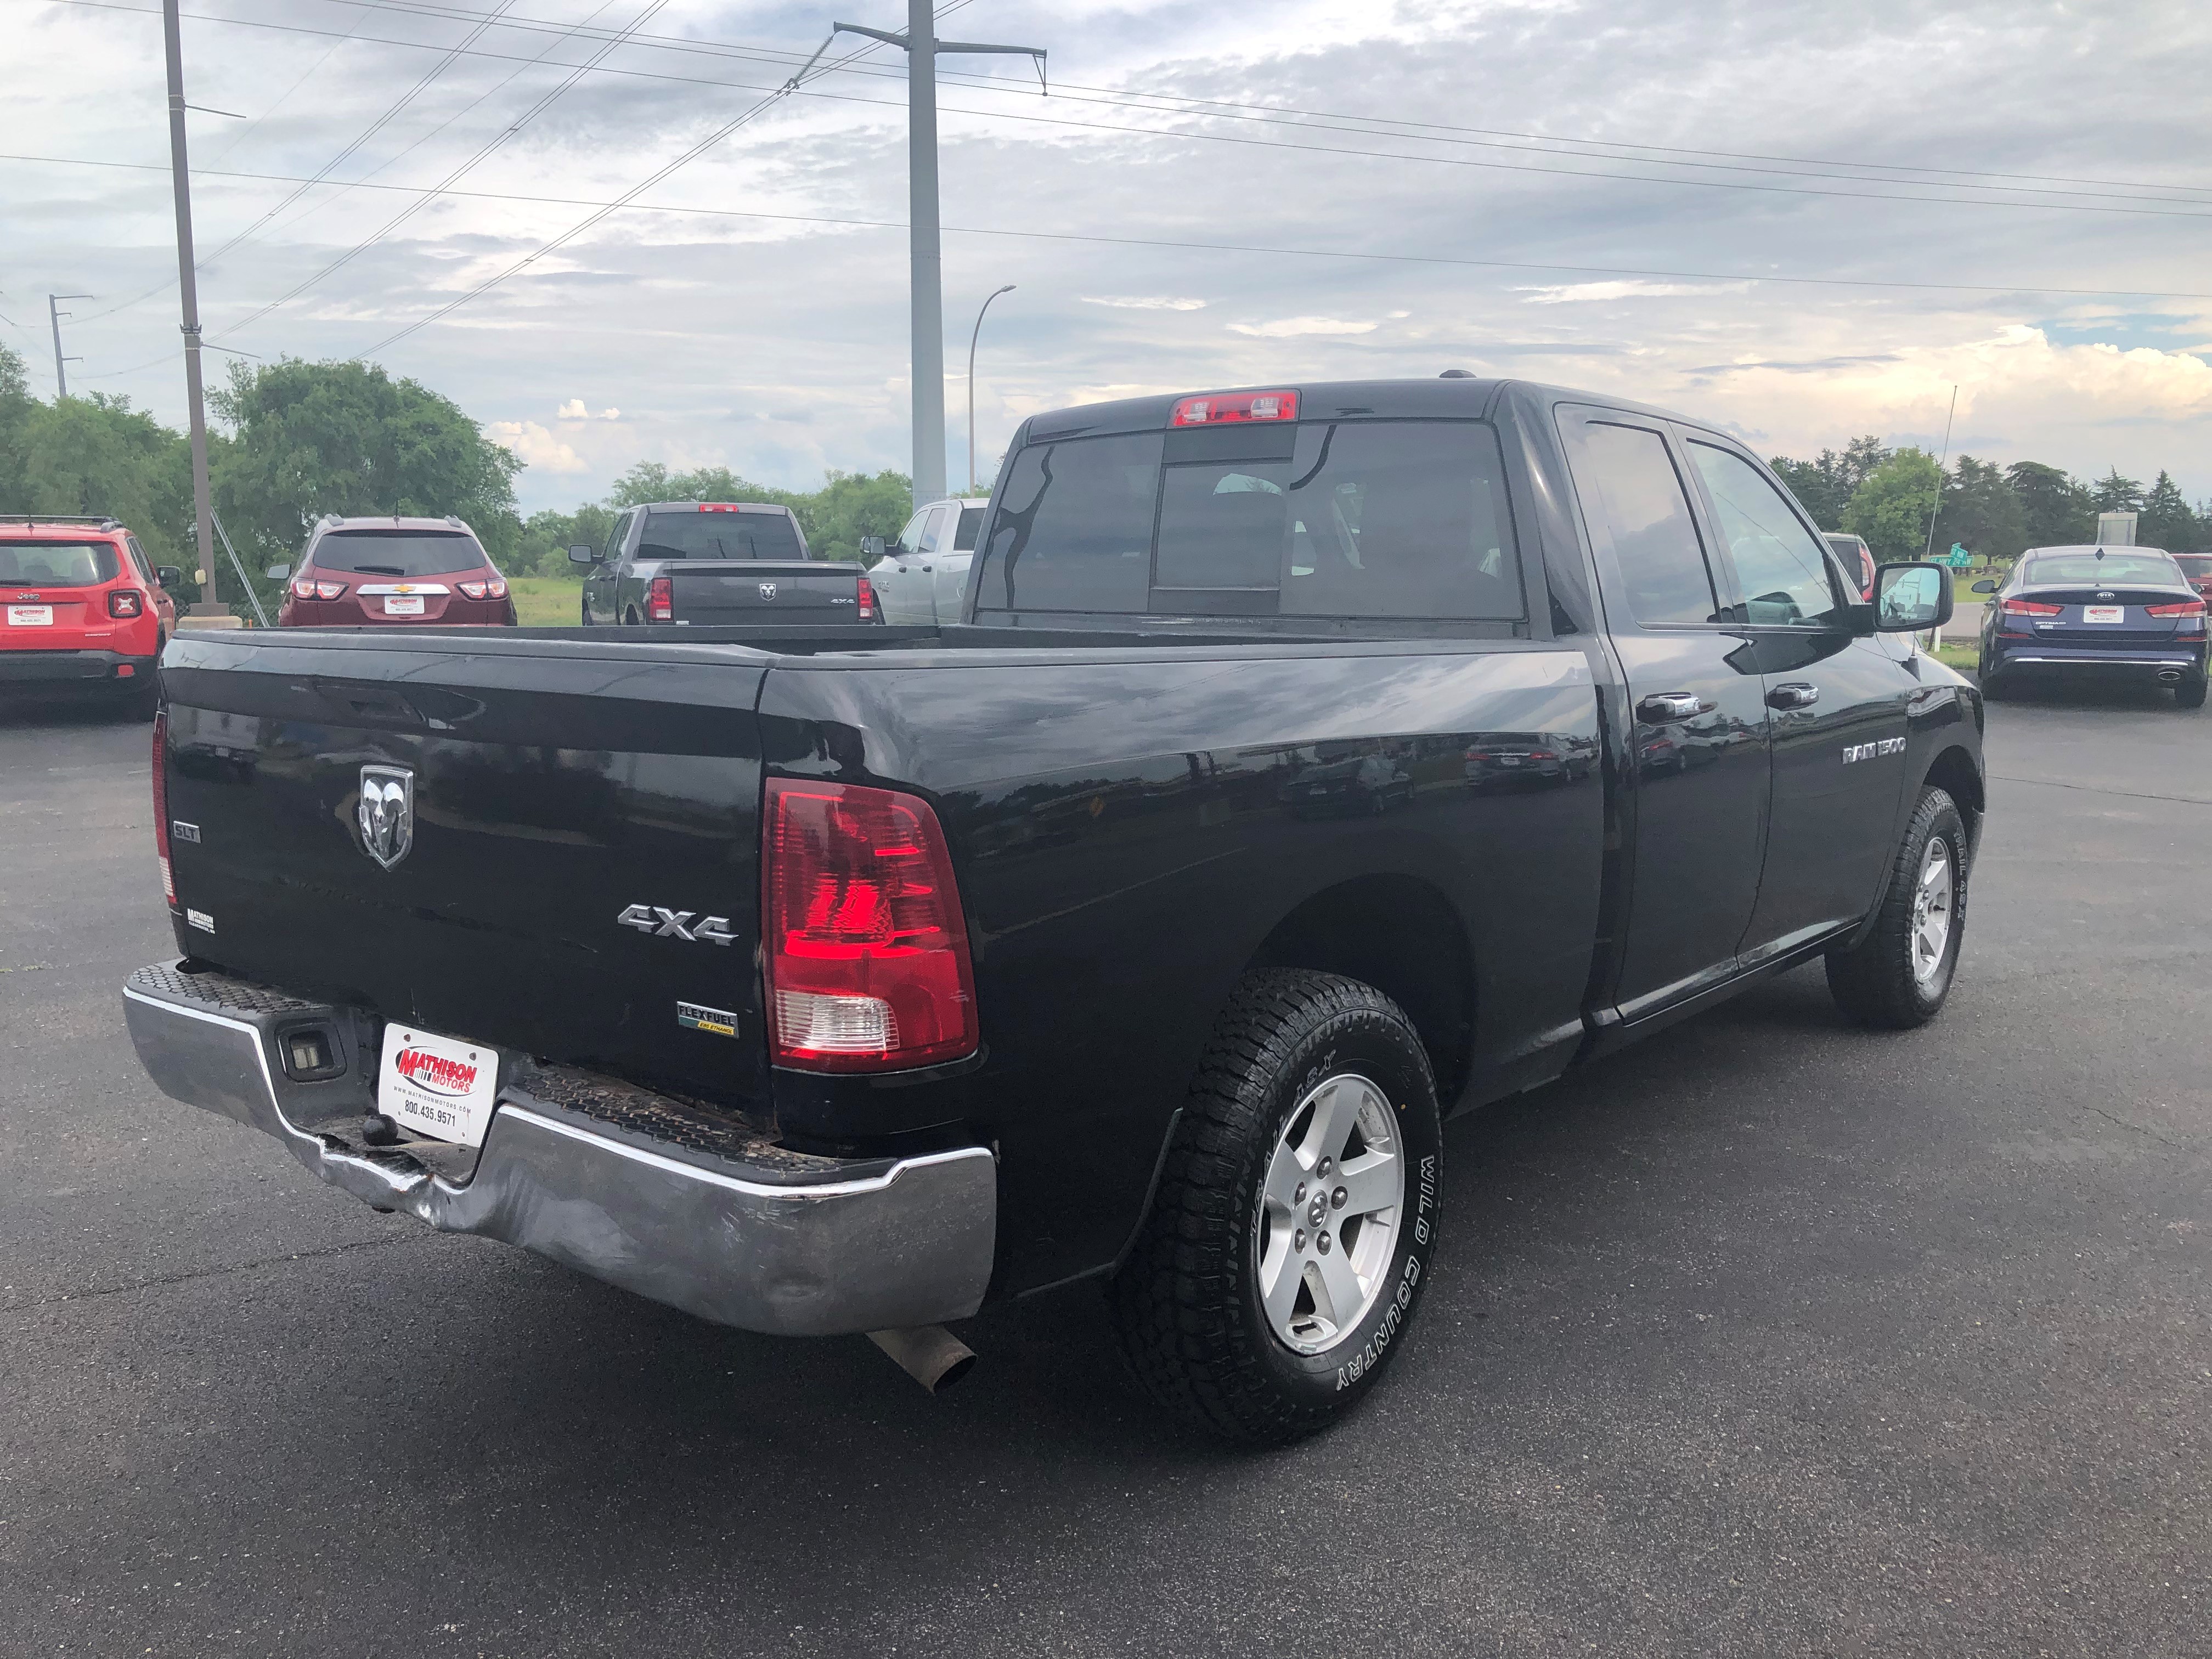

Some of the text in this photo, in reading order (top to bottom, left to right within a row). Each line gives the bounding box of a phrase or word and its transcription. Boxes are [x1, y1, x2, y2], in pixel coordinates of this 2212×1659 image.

[17, 592, 40, 602] Jeep
[1843, 742, 1876, 764] RAM
[175, 825, 195, 839] SLT
[187, 908, 213, 924] MATHISON
[618, 904, 740, 946] 4X4
[710, 1024, 733, 1035] ETHANOL
[398, 1048, 478, 1084] MATHISON
[431, 1073, 471, 1093] MOTORS
[393, 1086, 472, 1114] WWW.MATHISONMOTORS.COM
[405, 1099, 456, 1127] 800.435.9571
[1336, 1154, 1435, 1391] WILD COUNTRY
